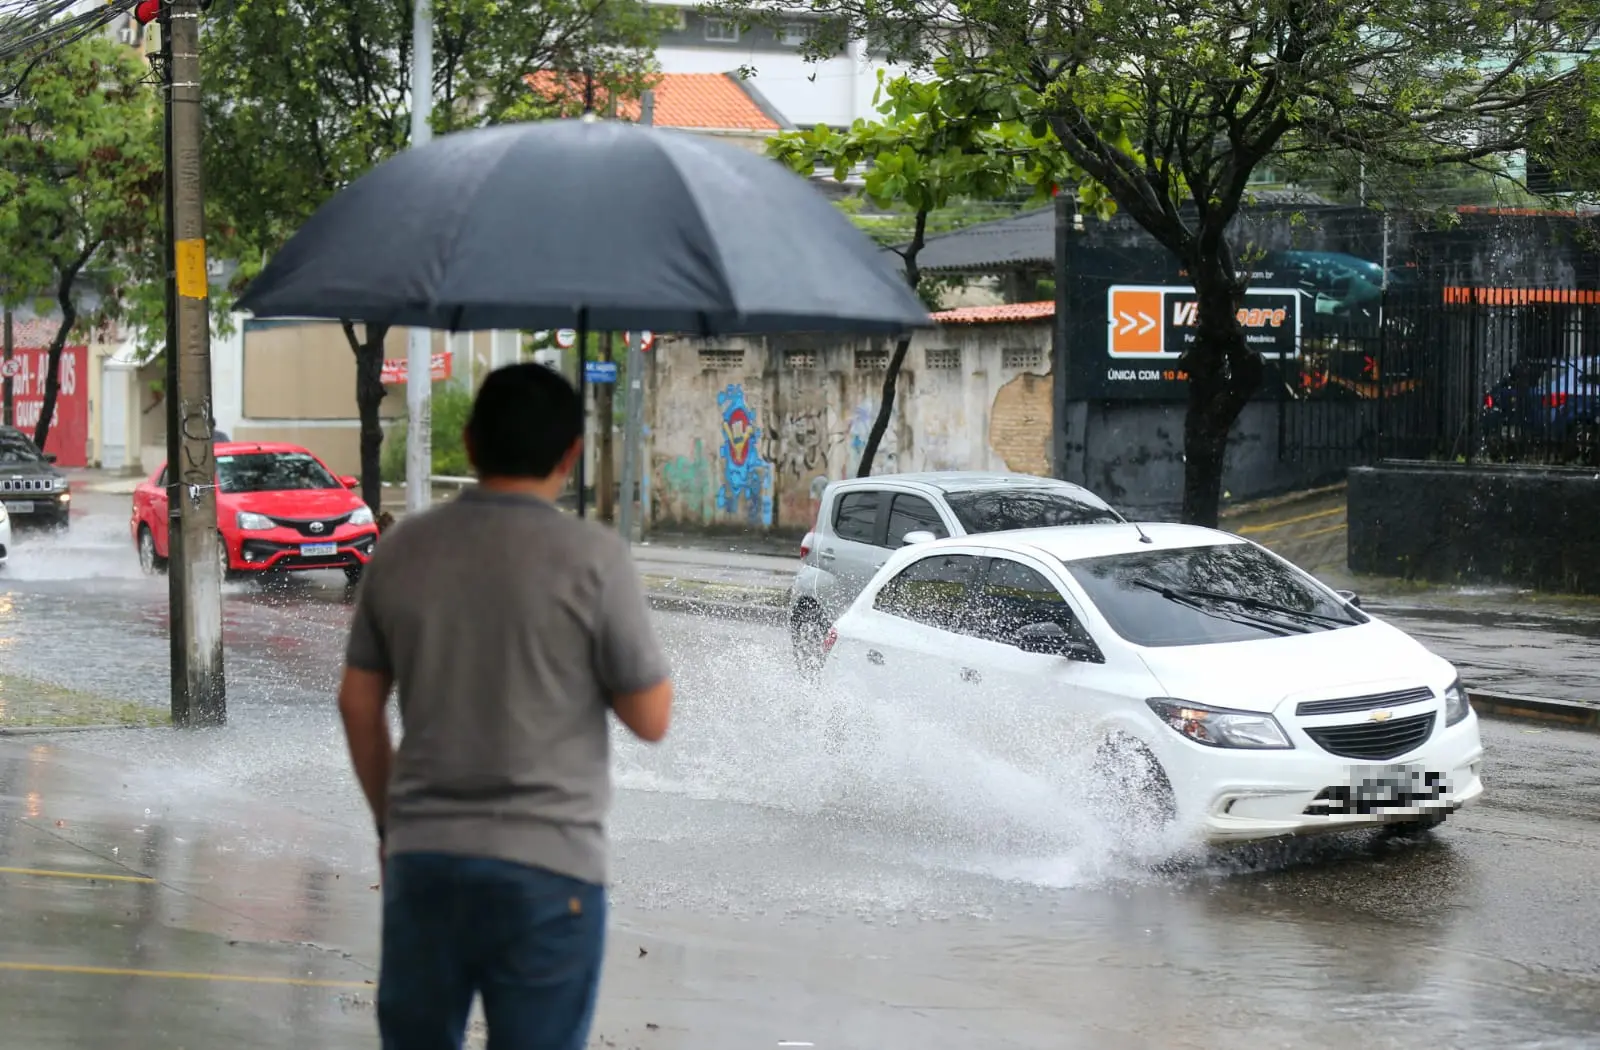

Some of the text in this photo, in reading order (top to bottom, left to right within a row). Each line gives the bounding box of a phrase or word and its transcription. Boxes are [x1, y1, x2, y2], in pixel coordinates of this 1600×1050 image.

[1107, 367, 1137, 380] ÚNICA
[1138, 369, 1160, 380] COM
[1163, 369, 1175, 380] 10
